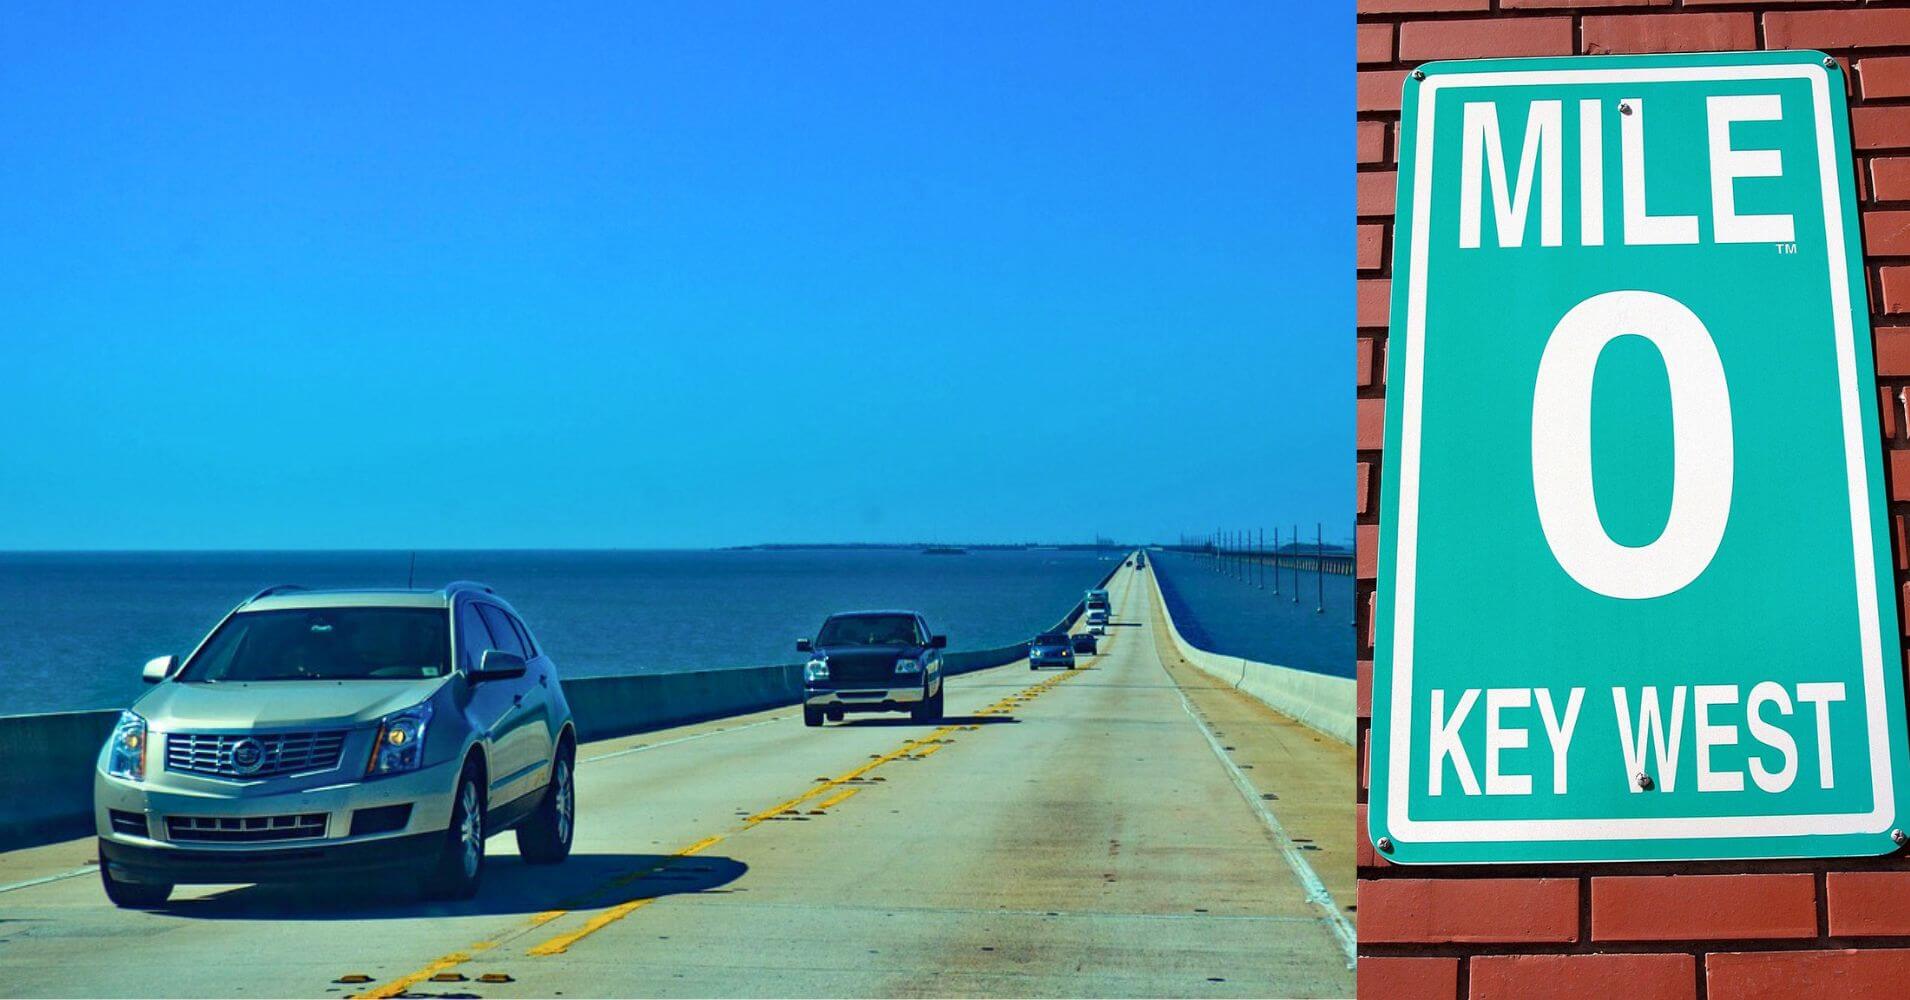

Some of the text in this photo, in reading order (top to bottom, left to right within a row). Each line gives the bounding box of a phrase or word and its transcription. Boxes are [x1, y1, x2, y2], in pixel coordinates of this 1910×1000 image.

[1459, 94, 1796, 249] MILE
[1776, 243, 1798, 254] TM
[1531, 290, 1735, 600] 0
[1428, 681, 1847, 796] KEY WEST
